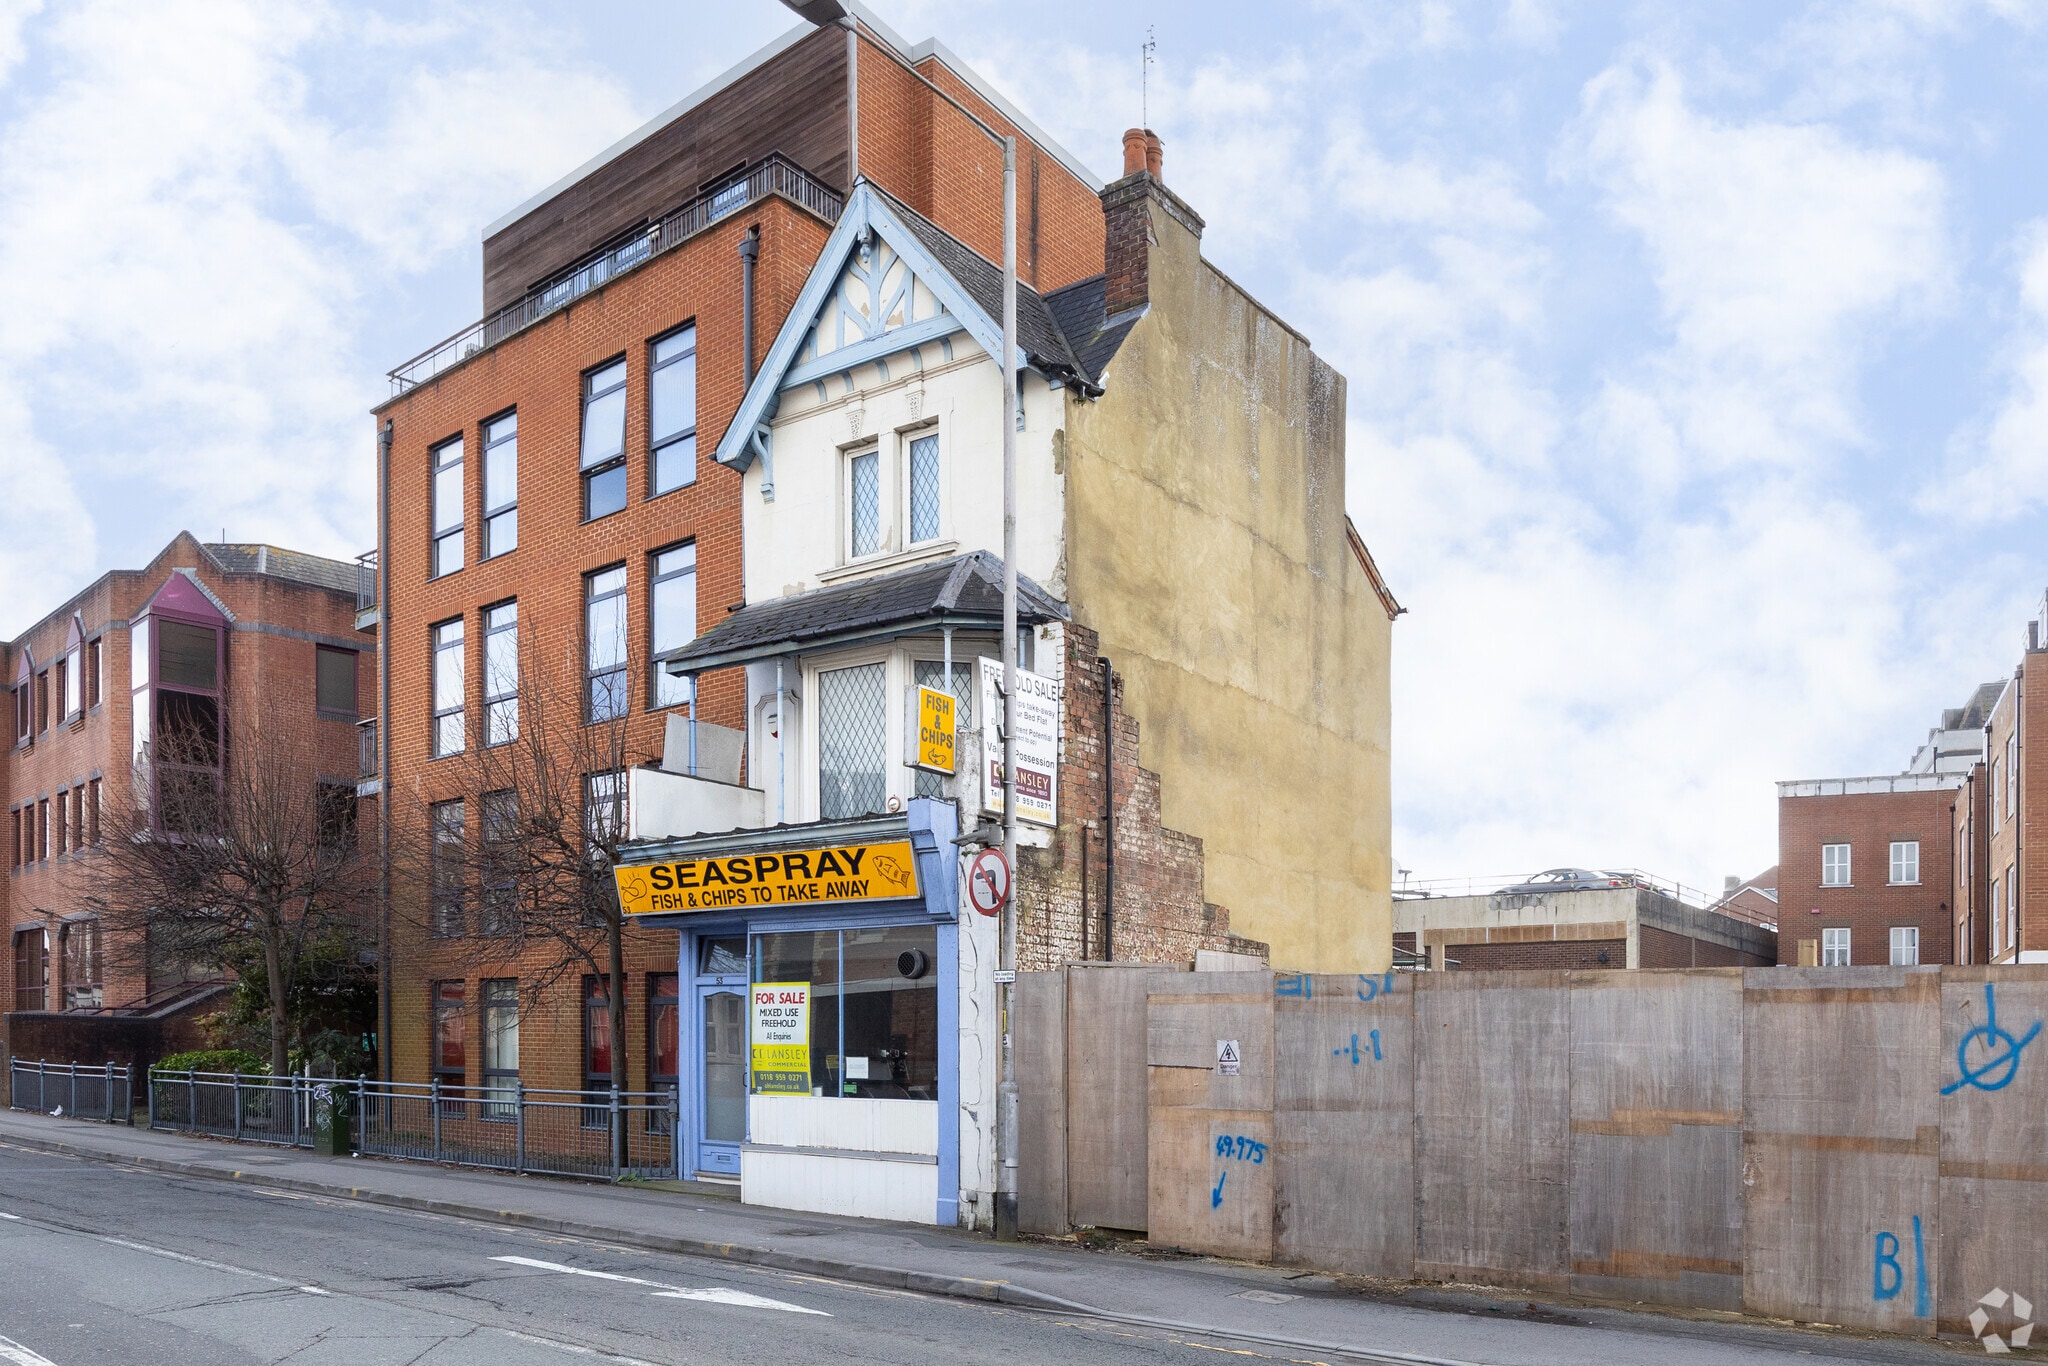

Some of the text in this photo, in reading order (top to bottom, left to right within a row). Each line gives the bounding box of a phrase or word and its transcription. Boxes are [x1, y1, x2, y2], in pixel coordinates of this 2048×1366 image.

[1035, 680, 1056, 702] SALE
[926, 694, 949, 715] FISH
[934, 715, 941, 730] &
[1024, 712, 1035, 722] Bed
[1037, 716, 1048, 726] Flat
[921, 727, 953, 749] CHIPS
[1036, 801, 1052, 810] 0271
[649, 848, 867, 890] SEASPRAY
[651, 880, 870, 910] FISH & CHIPS TO TAKE AWAY
[623, 906, 631, 914] 53
[755, 992, 805, 1004] FOR SALE
[759, 1008, 799, 1017] MIXED USE
[761, 1019, 797, 1028] FREEHOLD
[767, 1049, 807, 1060] LANSLEY
[760, 1073, 773, 1081] 0118
[788, 1074, 802, 1082] 0271
[1216, 1135, 1268, 1164] 49.975
